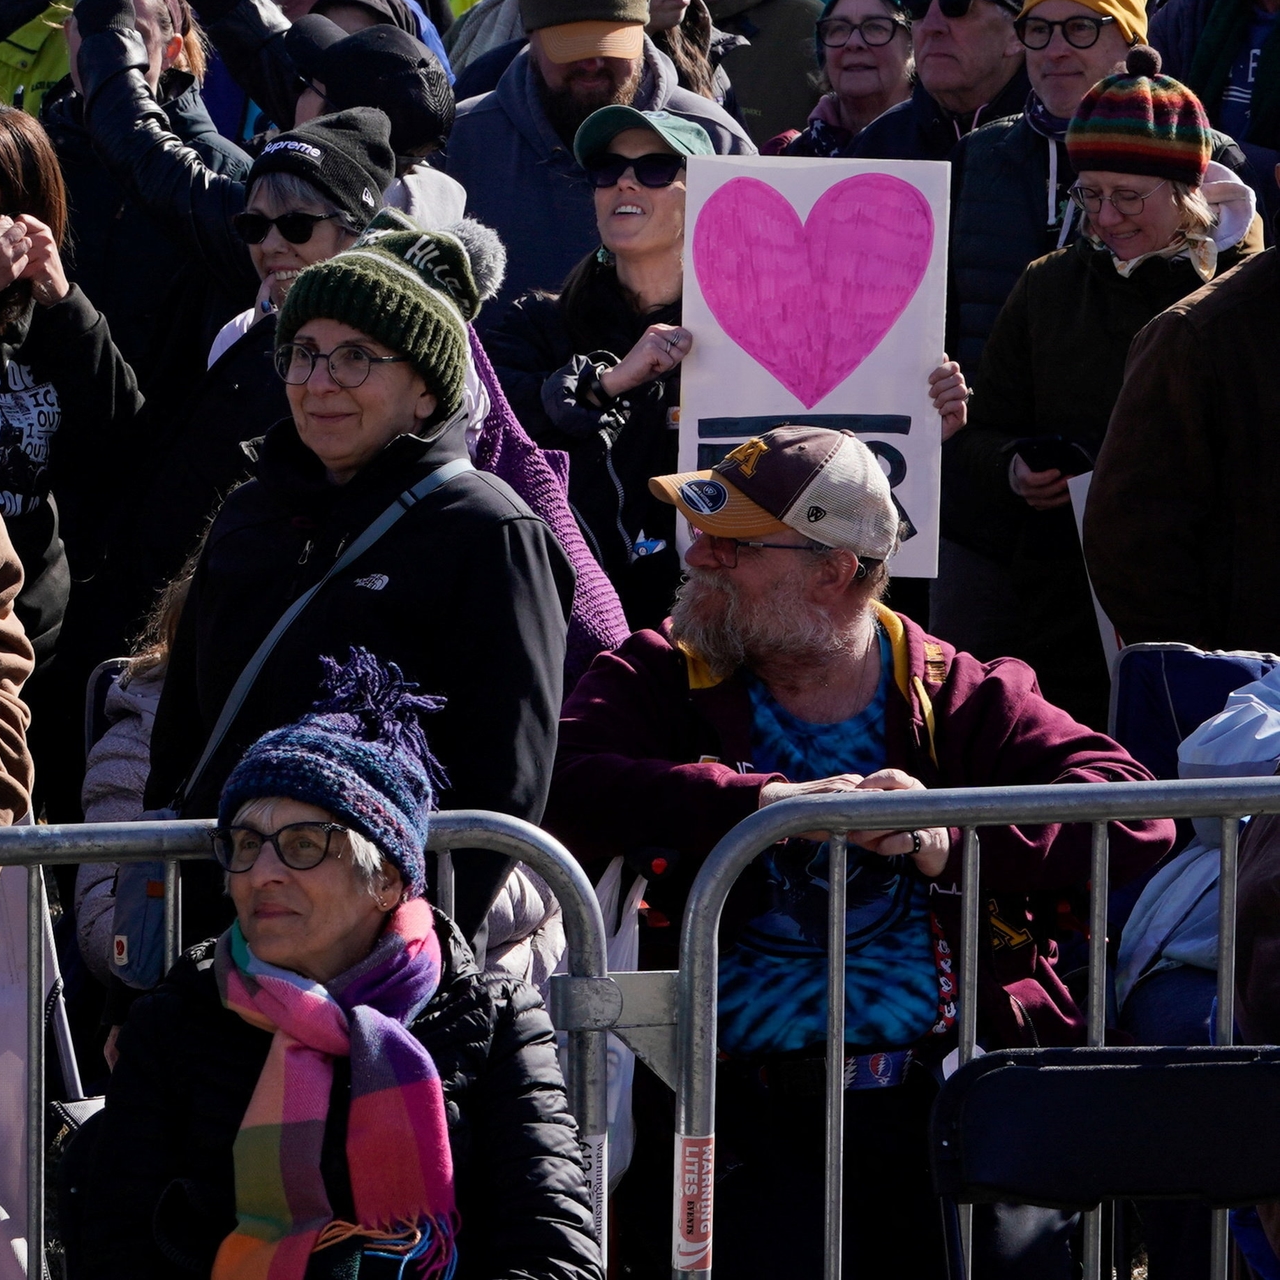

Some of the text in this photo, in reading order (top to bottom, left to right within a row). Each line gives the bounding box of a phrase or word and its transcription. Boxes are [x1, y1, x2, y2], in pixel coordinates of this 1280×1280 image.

[262, 138, 323, 159] Supreme
[684, 1145, 699, 1235] LITES EVENTS
[699, 1144, 714, 1234] WARNING
